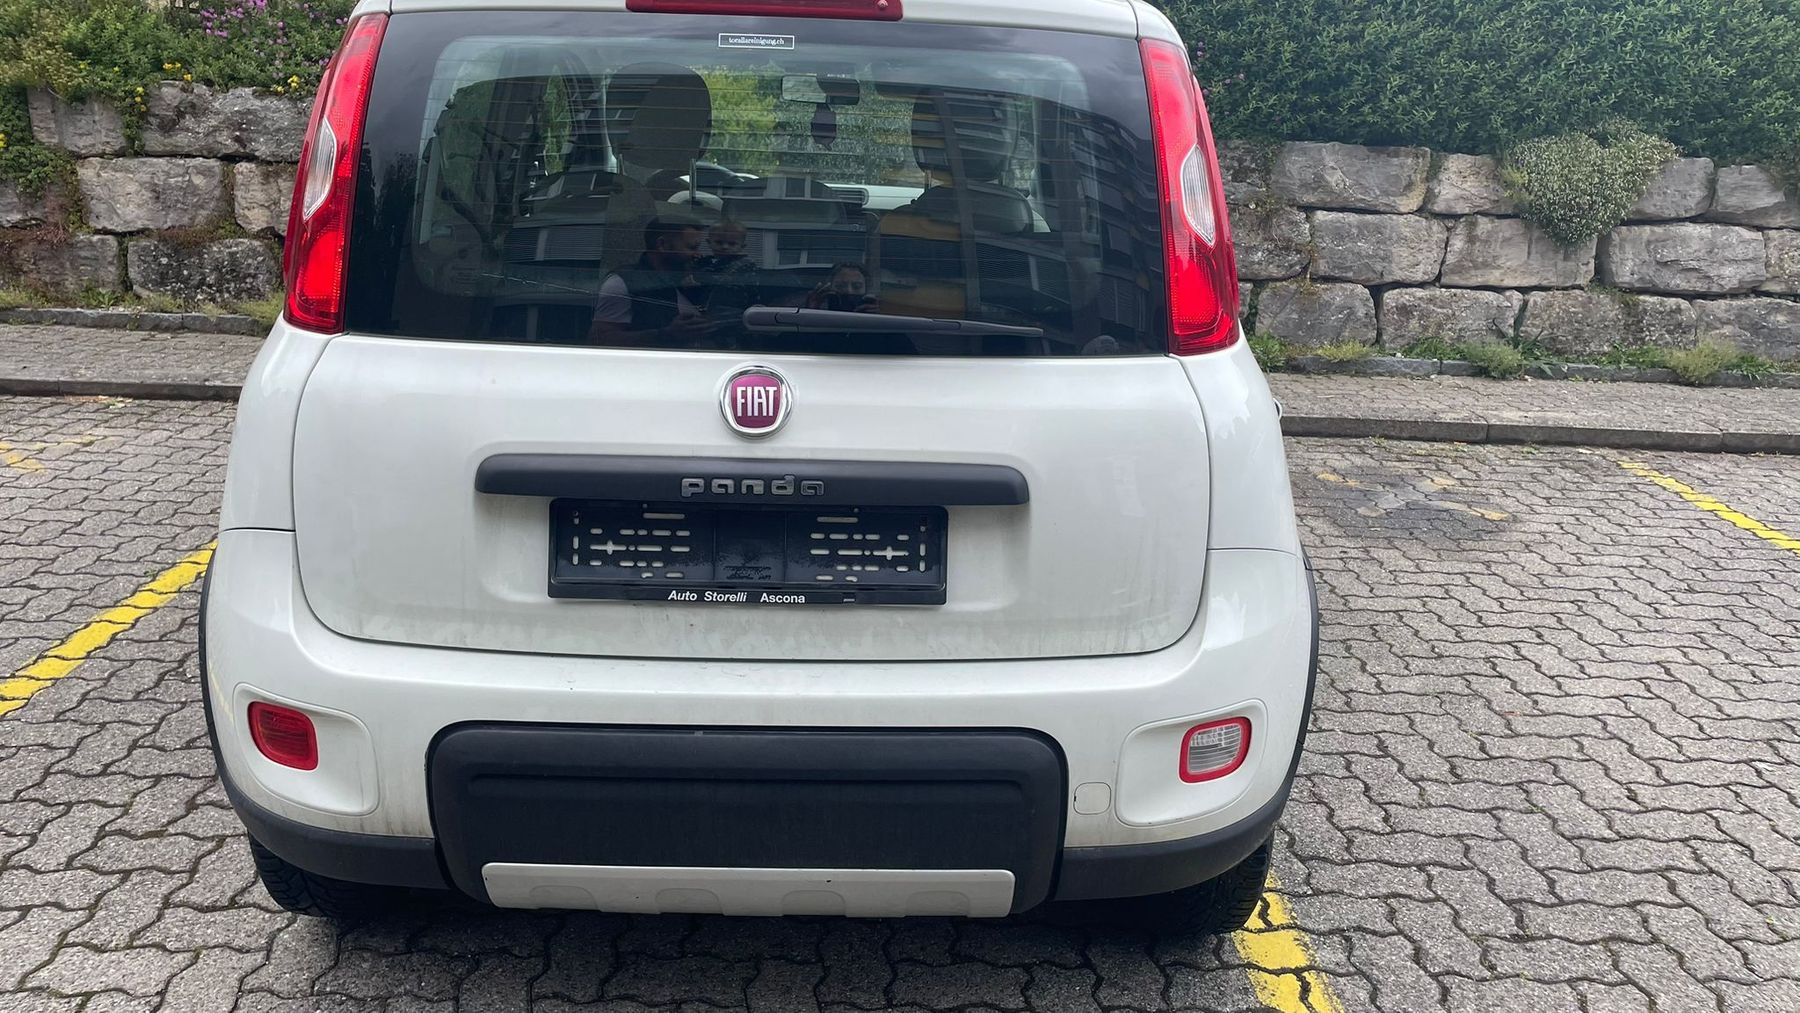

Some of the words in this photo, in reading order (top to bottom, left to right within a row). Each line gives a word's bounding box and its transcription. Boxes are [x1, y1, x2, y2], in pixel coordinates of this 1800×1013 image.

[736, 386, 778, 417] FIAT
[681, 473, 825, 497] panda
[667, 590, 698, 602] Auto
[704, 590, 748, 603] Storelli
[760, 592, 806, 604] Ascona
